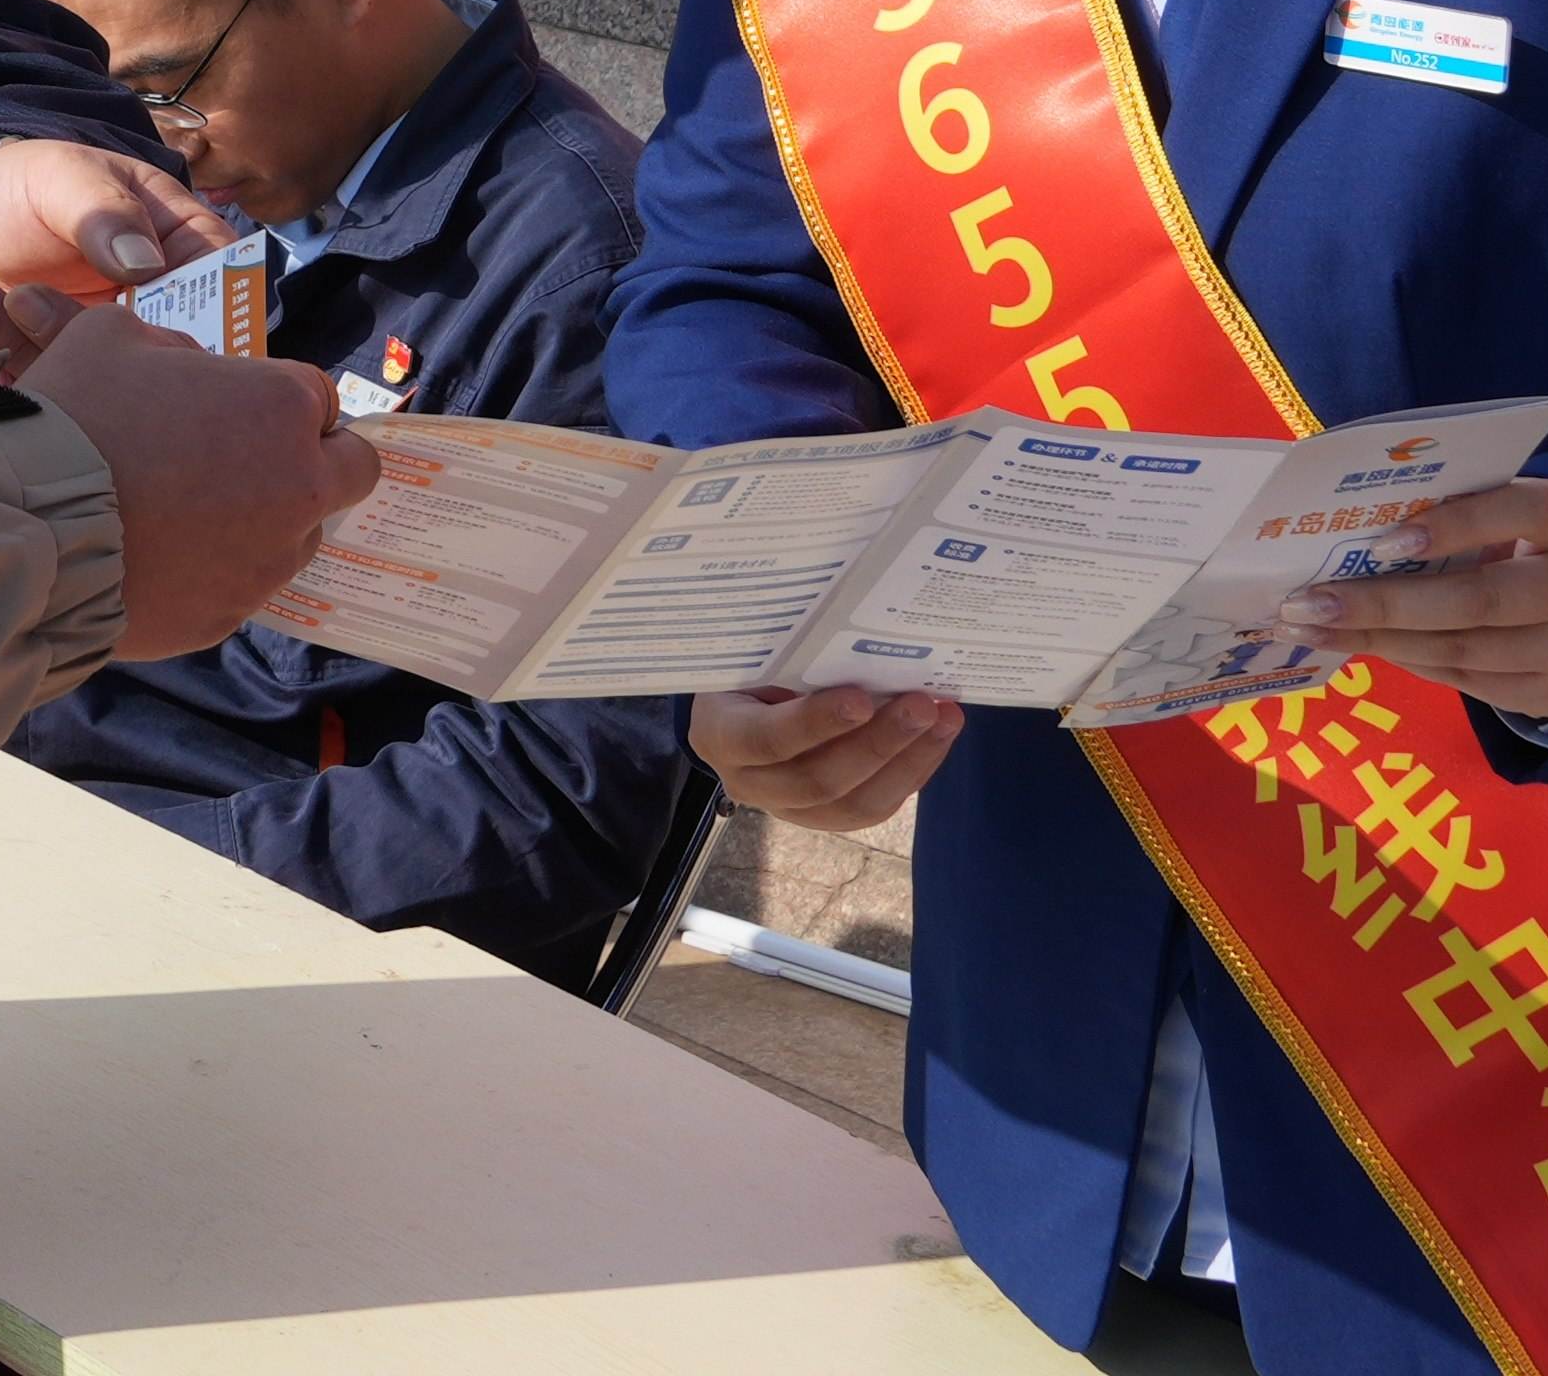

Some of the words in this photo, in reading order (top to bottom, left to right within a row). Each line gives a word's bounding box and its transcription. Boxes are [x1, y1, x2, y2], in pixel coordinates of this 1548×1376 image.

[1370, 13, 1425, 33] 青岛能源
[1390, 49, 1439, 71] No.252
[1100, 453, 1118, 464] &
[1339, 461, 1448, 486] 青岛能源
[1334, 480, 1387, 494] Qingdao
[1390, 474, 1438, 486] Energy
